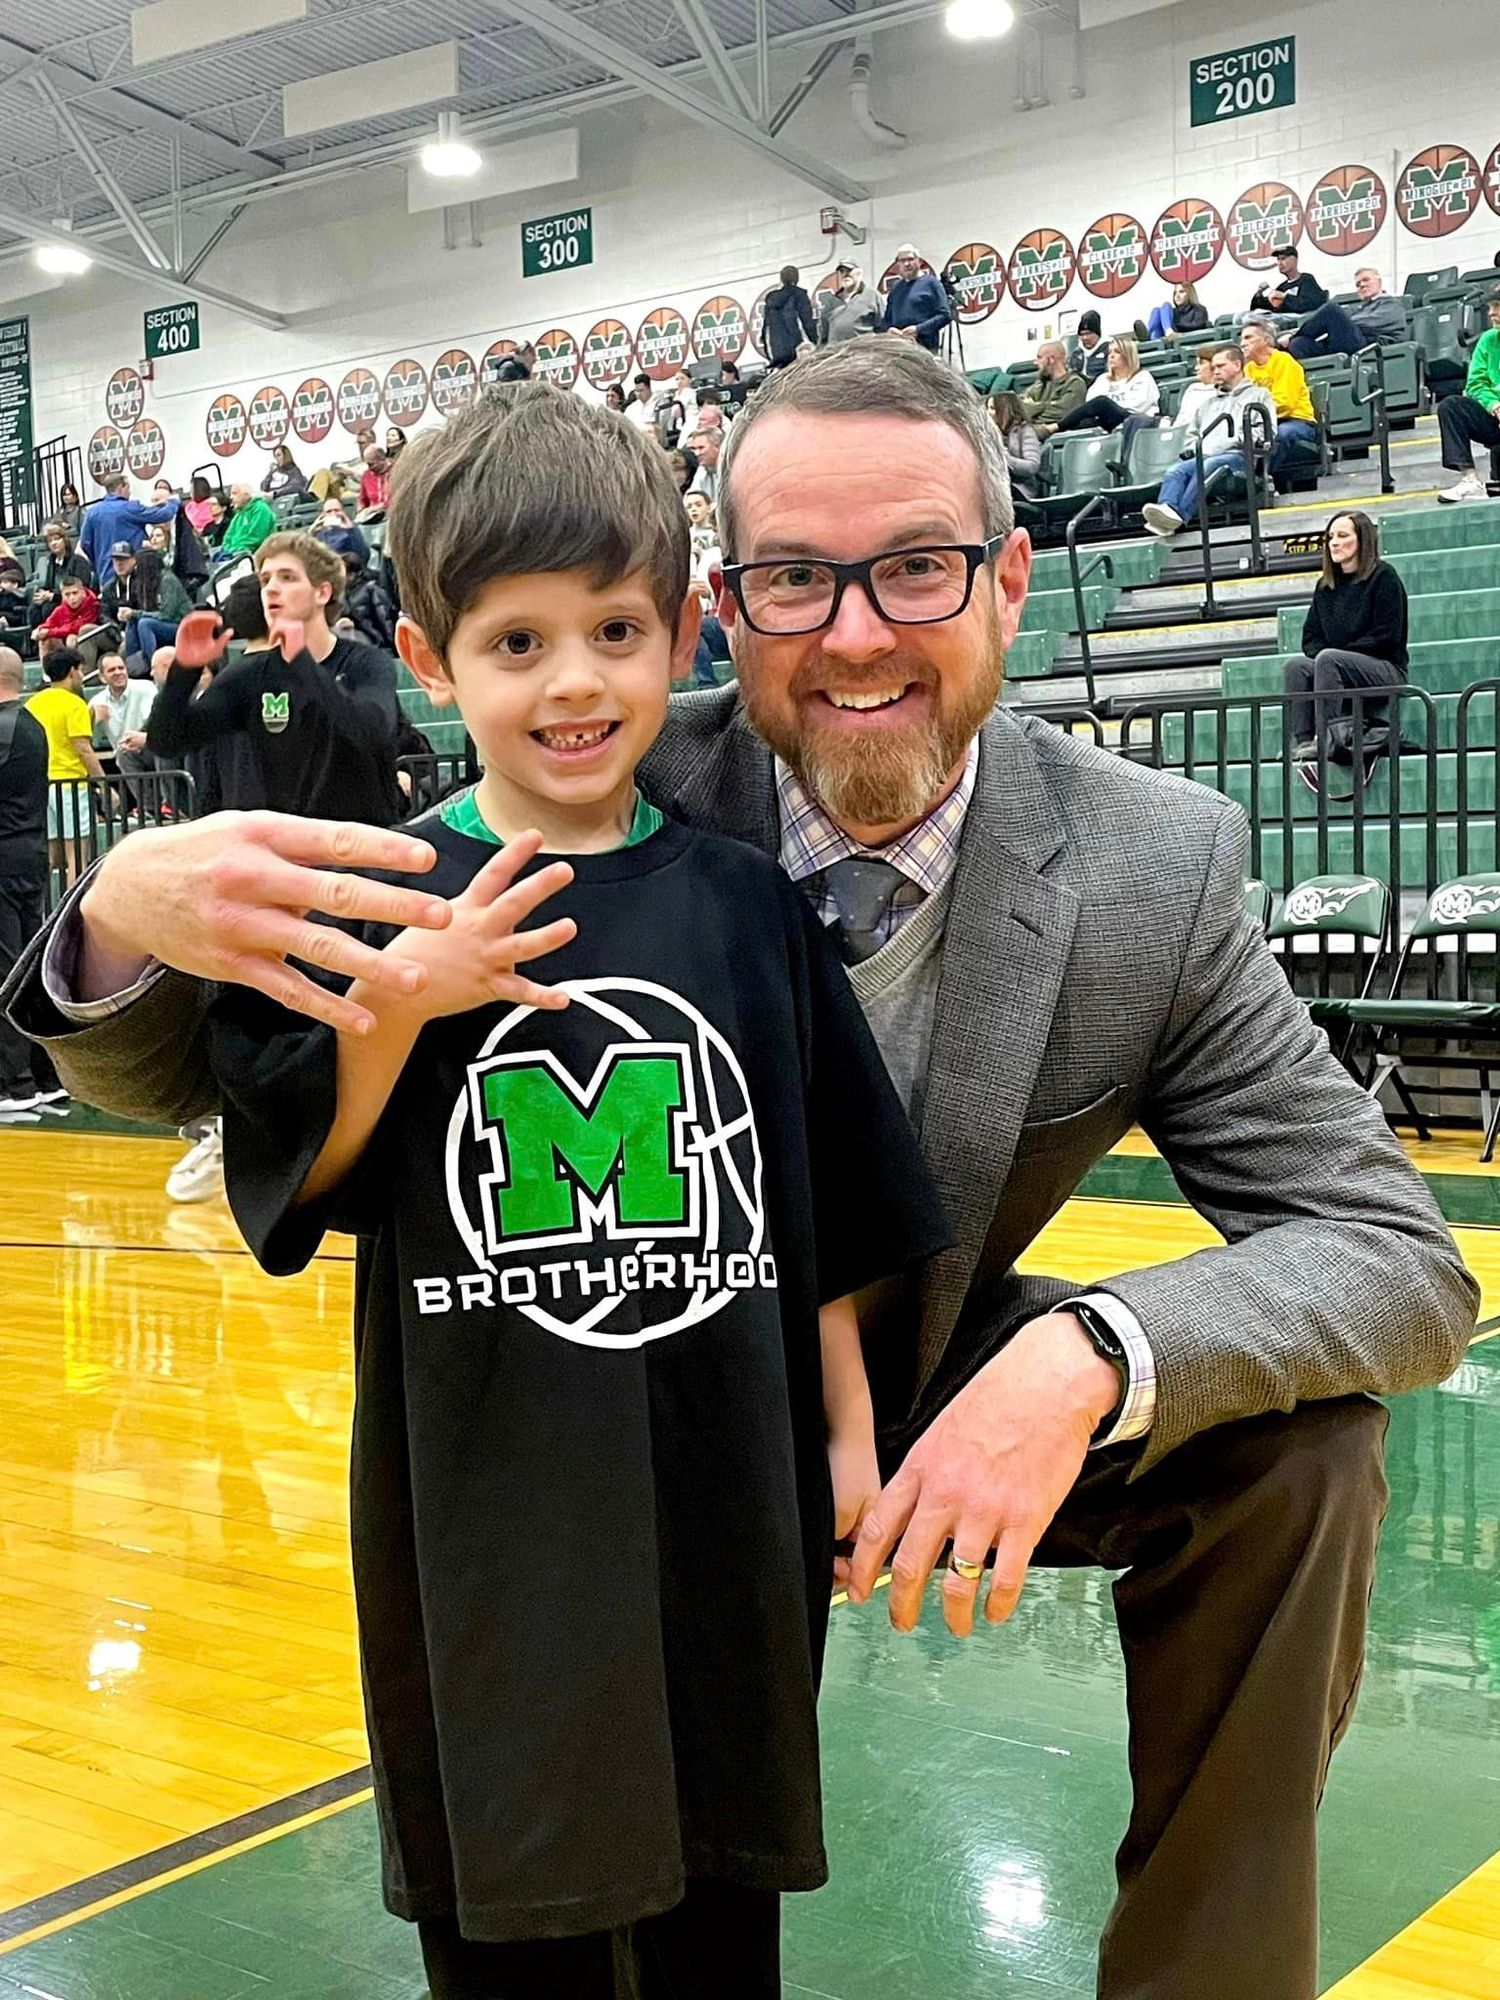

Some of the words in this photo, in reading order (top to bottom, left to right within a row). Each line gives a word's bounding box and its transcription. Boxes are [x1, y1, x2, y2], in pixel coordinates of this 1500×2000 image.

[1196, 43, 1290, 84] SECTION
[1215, 72, 1275, 116] 200
[1315, 178, 1376, 240] M
[1407, 158, 1469, 222] M
[525, 213, 588, 243] SECTION
[1160, 211, 1214, 270] M
[1235, 194, 1293, 255] M
[537, 236, 579, 269] 300
[1016, 241, 1067, 297] M
[1087, 225, 1138, 284] M
[146, 305, 196, 330] SECTION
[157, 324, 190, 351] 400
[262, 692, 289, 718] M
[467, 1042, 700, 1255] M
